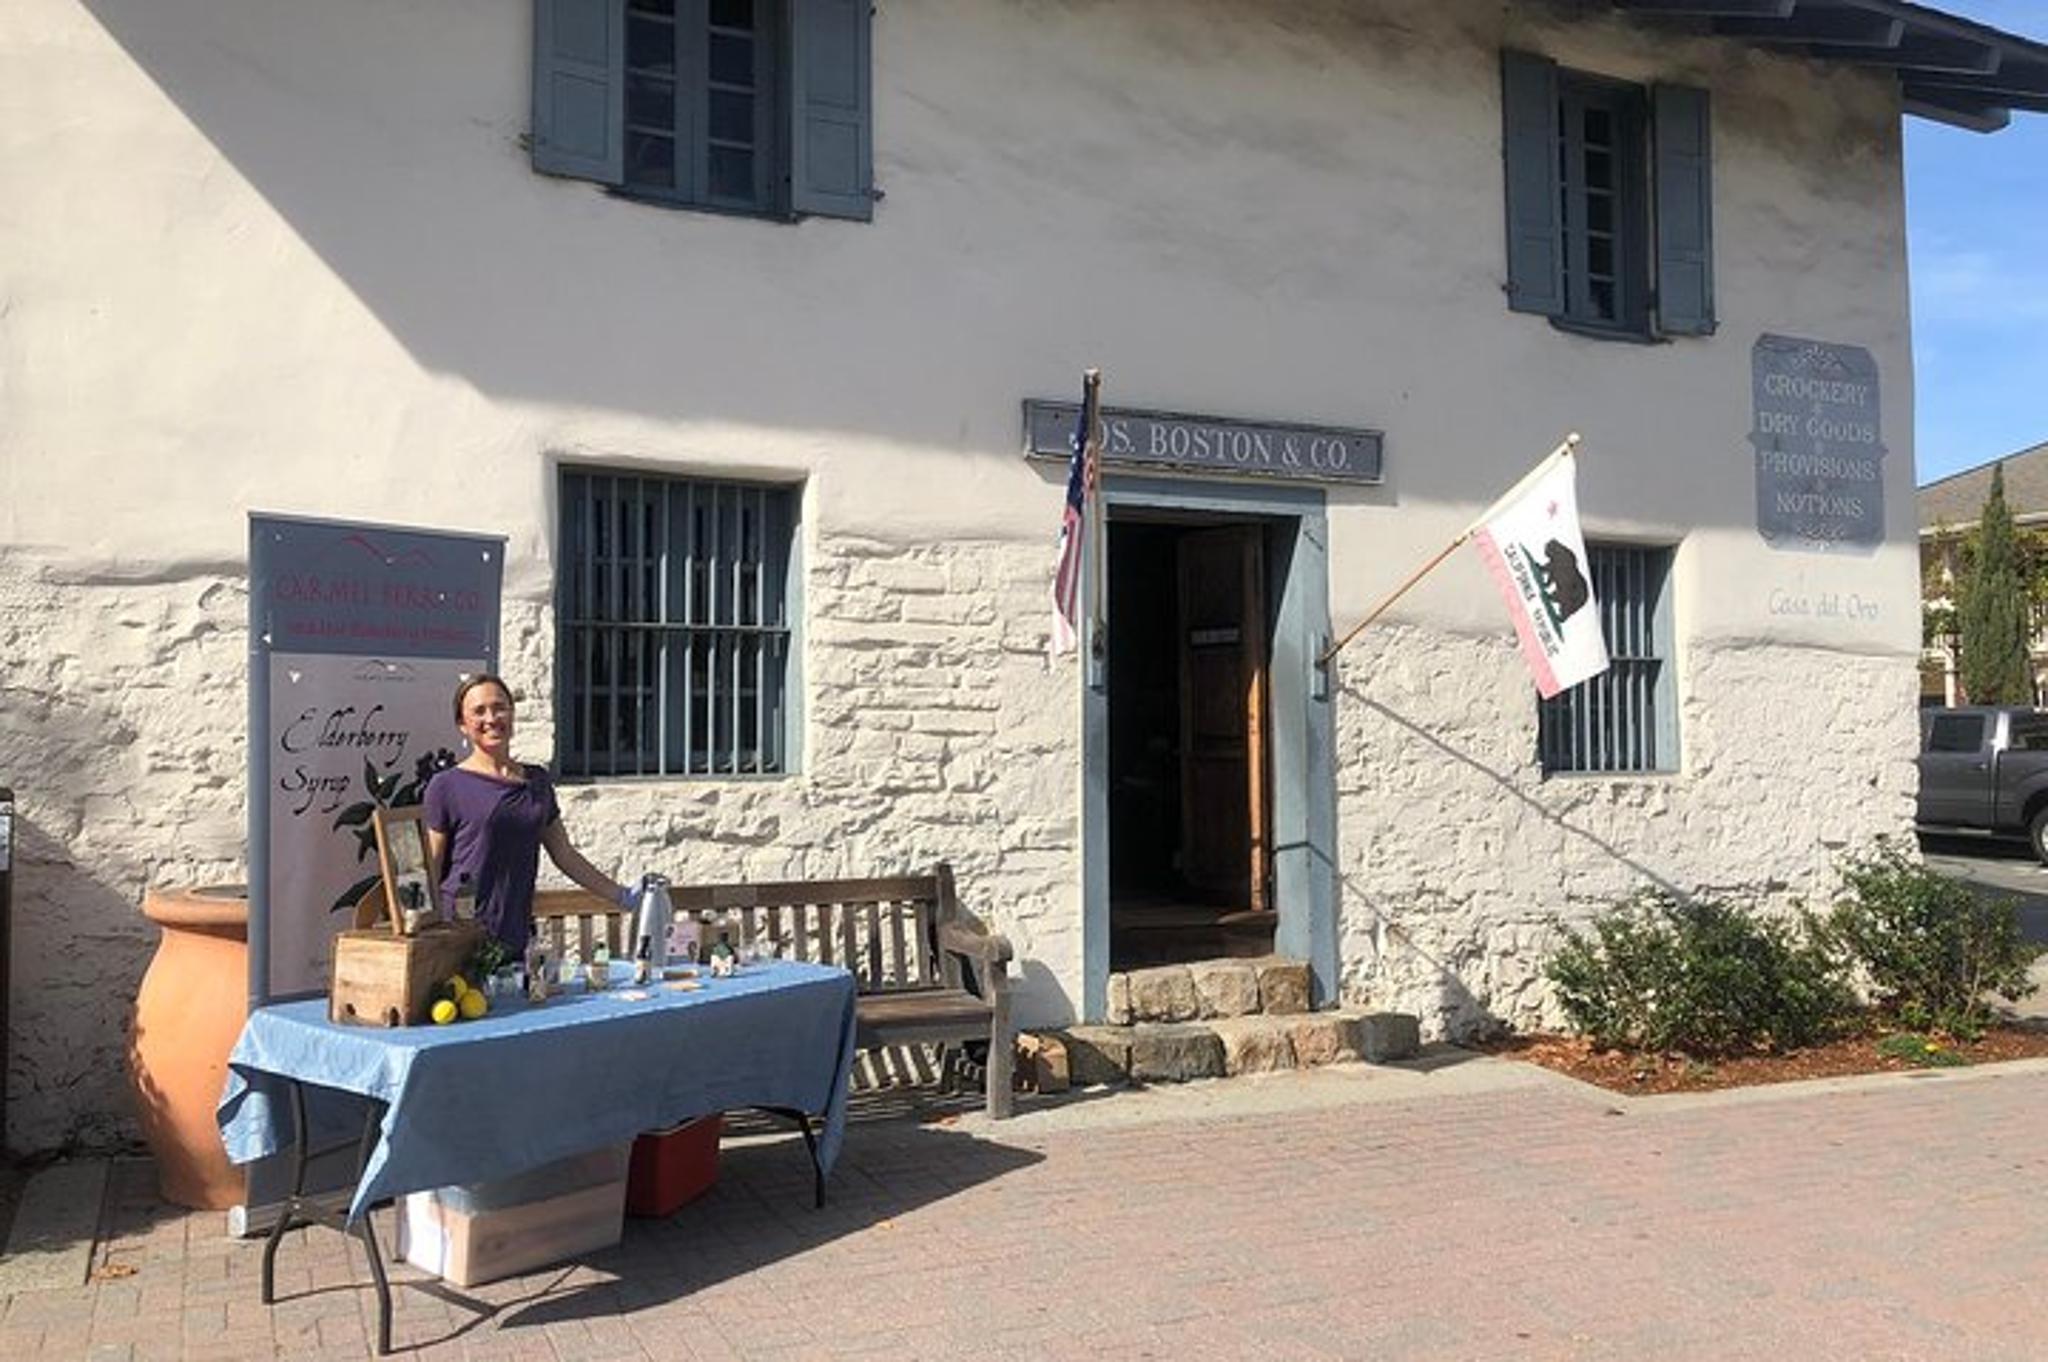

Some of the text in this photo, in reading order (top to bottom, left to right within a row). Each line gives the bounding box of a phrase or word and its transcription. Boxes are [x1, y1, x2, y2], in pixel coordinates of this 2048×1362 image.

[1765, 375, 1867, 408] CROCKERY
[1760, 411, 1876, 444] DRY GOODS
[1150, 422, 1273, 463] BOSTON
[1282, 437, 1301, 467] &
[1310, 439, 1352, 470] CO.
[1761, 449, 1876, 481] PROVISIONS
[1776, 492, 1865, 519] NOTIONS
[281, 704, 409, 768] Elderberry
[281, 764, 350, 815] Syrup
